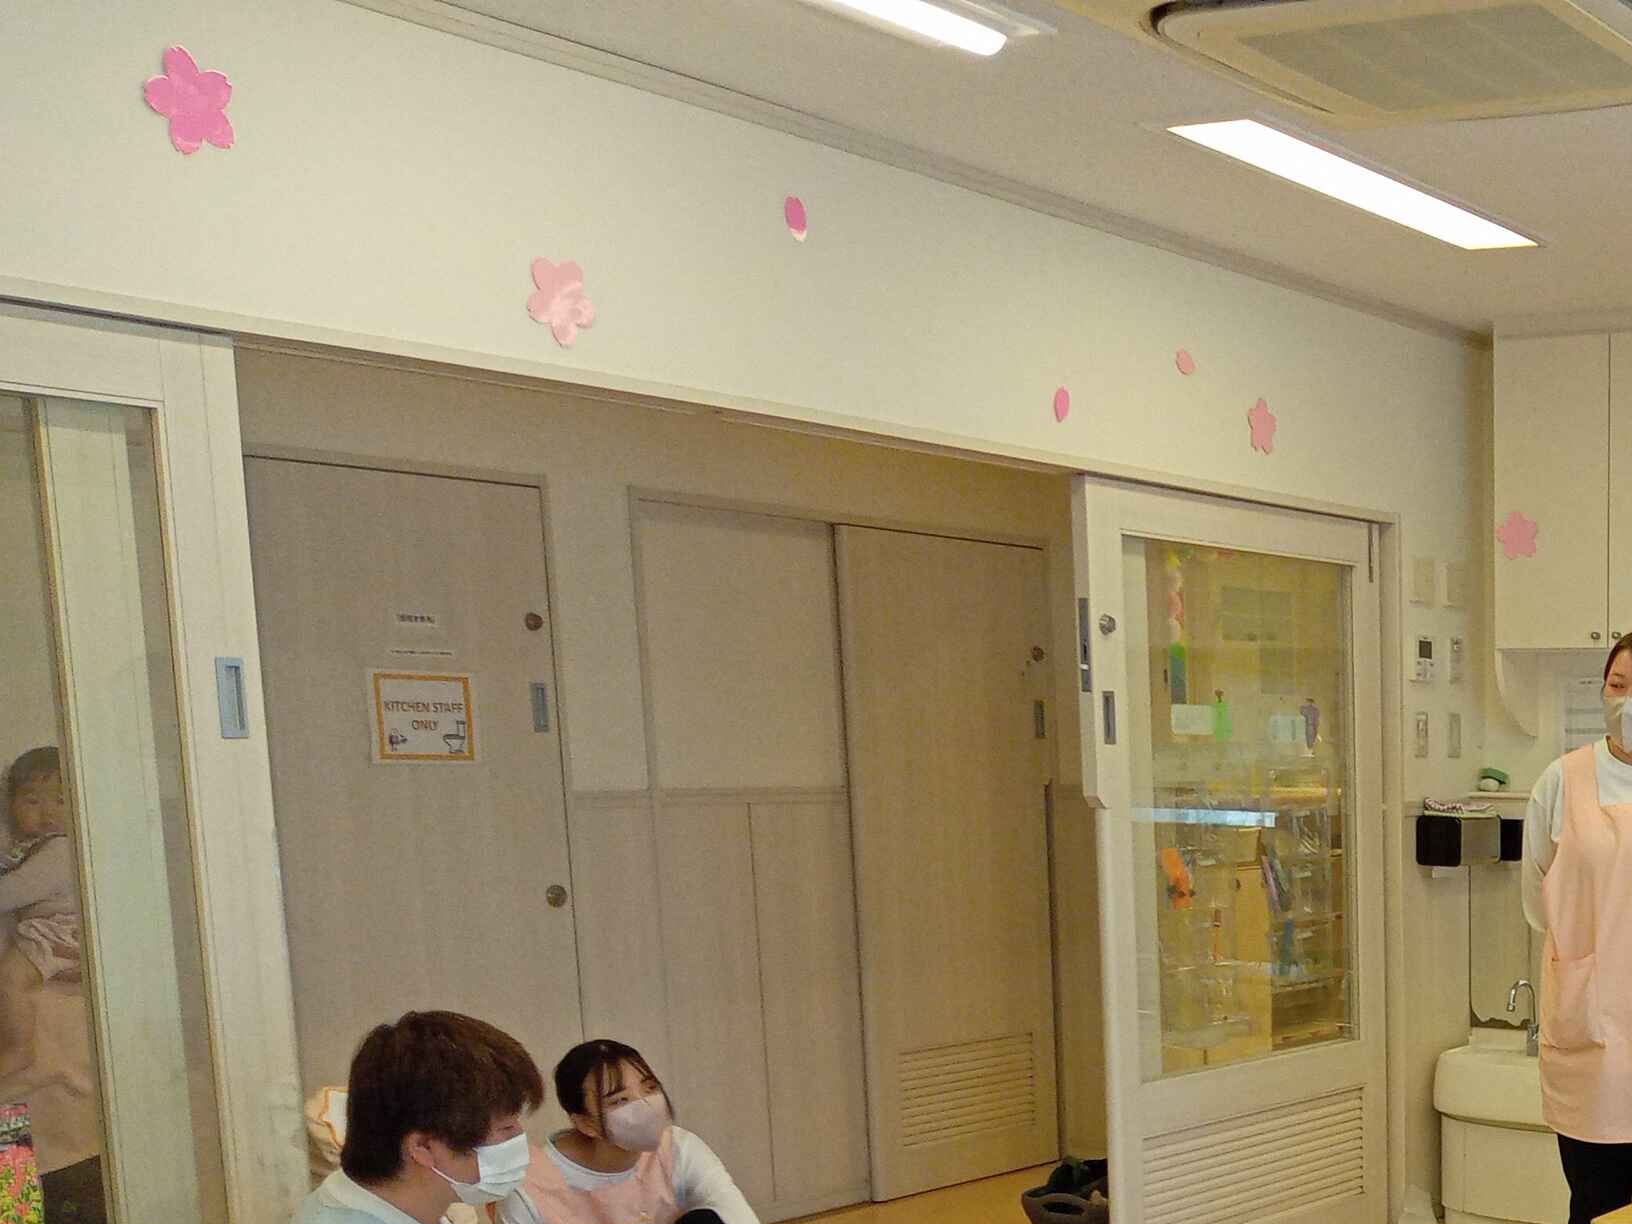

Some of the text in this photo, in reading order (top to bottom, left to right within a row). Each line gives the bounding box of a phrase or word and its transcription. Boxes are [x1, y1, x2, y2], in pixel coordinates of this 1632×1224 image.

[384, 701, 464, 713] KITCHEN STAFF
[411, 719, 439, 731] ONLY
